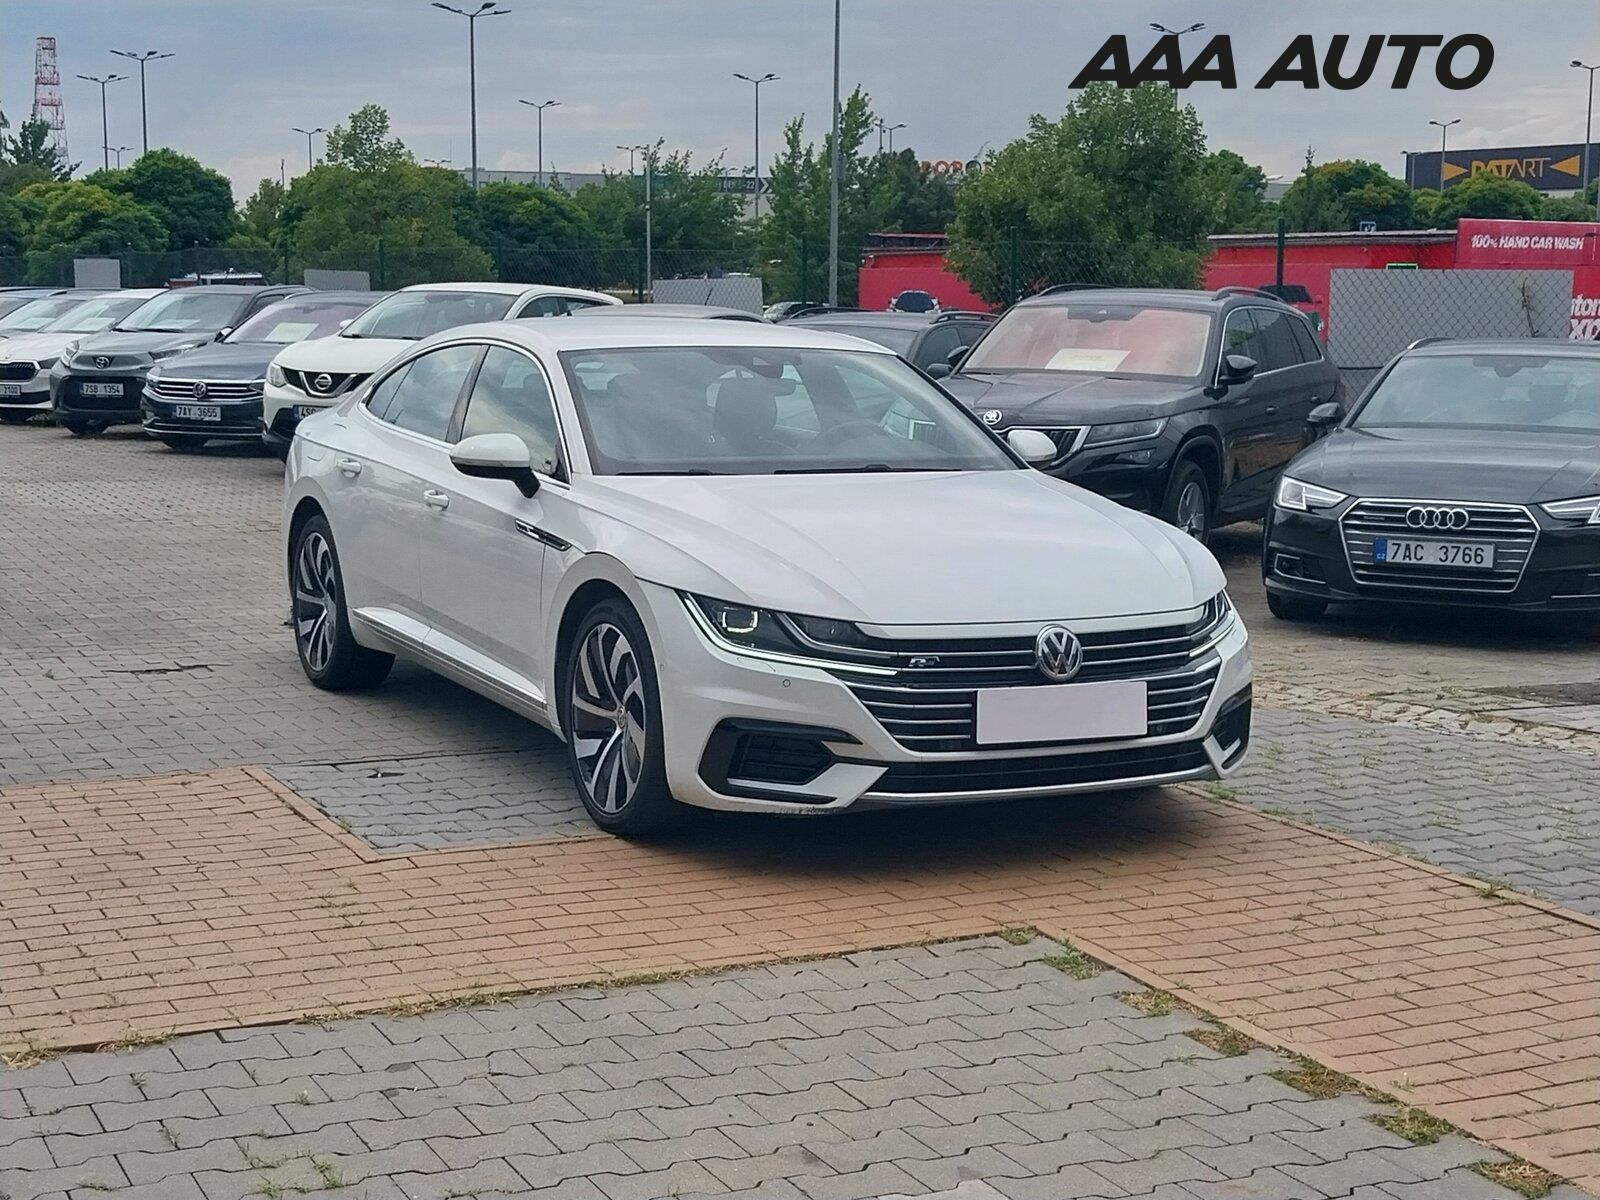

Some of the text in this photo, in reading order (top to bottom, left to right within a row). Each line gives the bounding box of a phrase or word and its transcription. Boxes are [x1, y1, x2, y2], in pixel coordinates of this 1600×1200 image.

[1471, 158, 1551, 178] DATART
[1471, 234, 1585, 250] 100% HAND CAR WASH
[85, 384, 120, 394] 7SB 1354
[178, 406, 192, 418] 7AY
[1376, 552, 1386, 560] CZ
[1391, 543, 1485, 564] 7AC 3766
